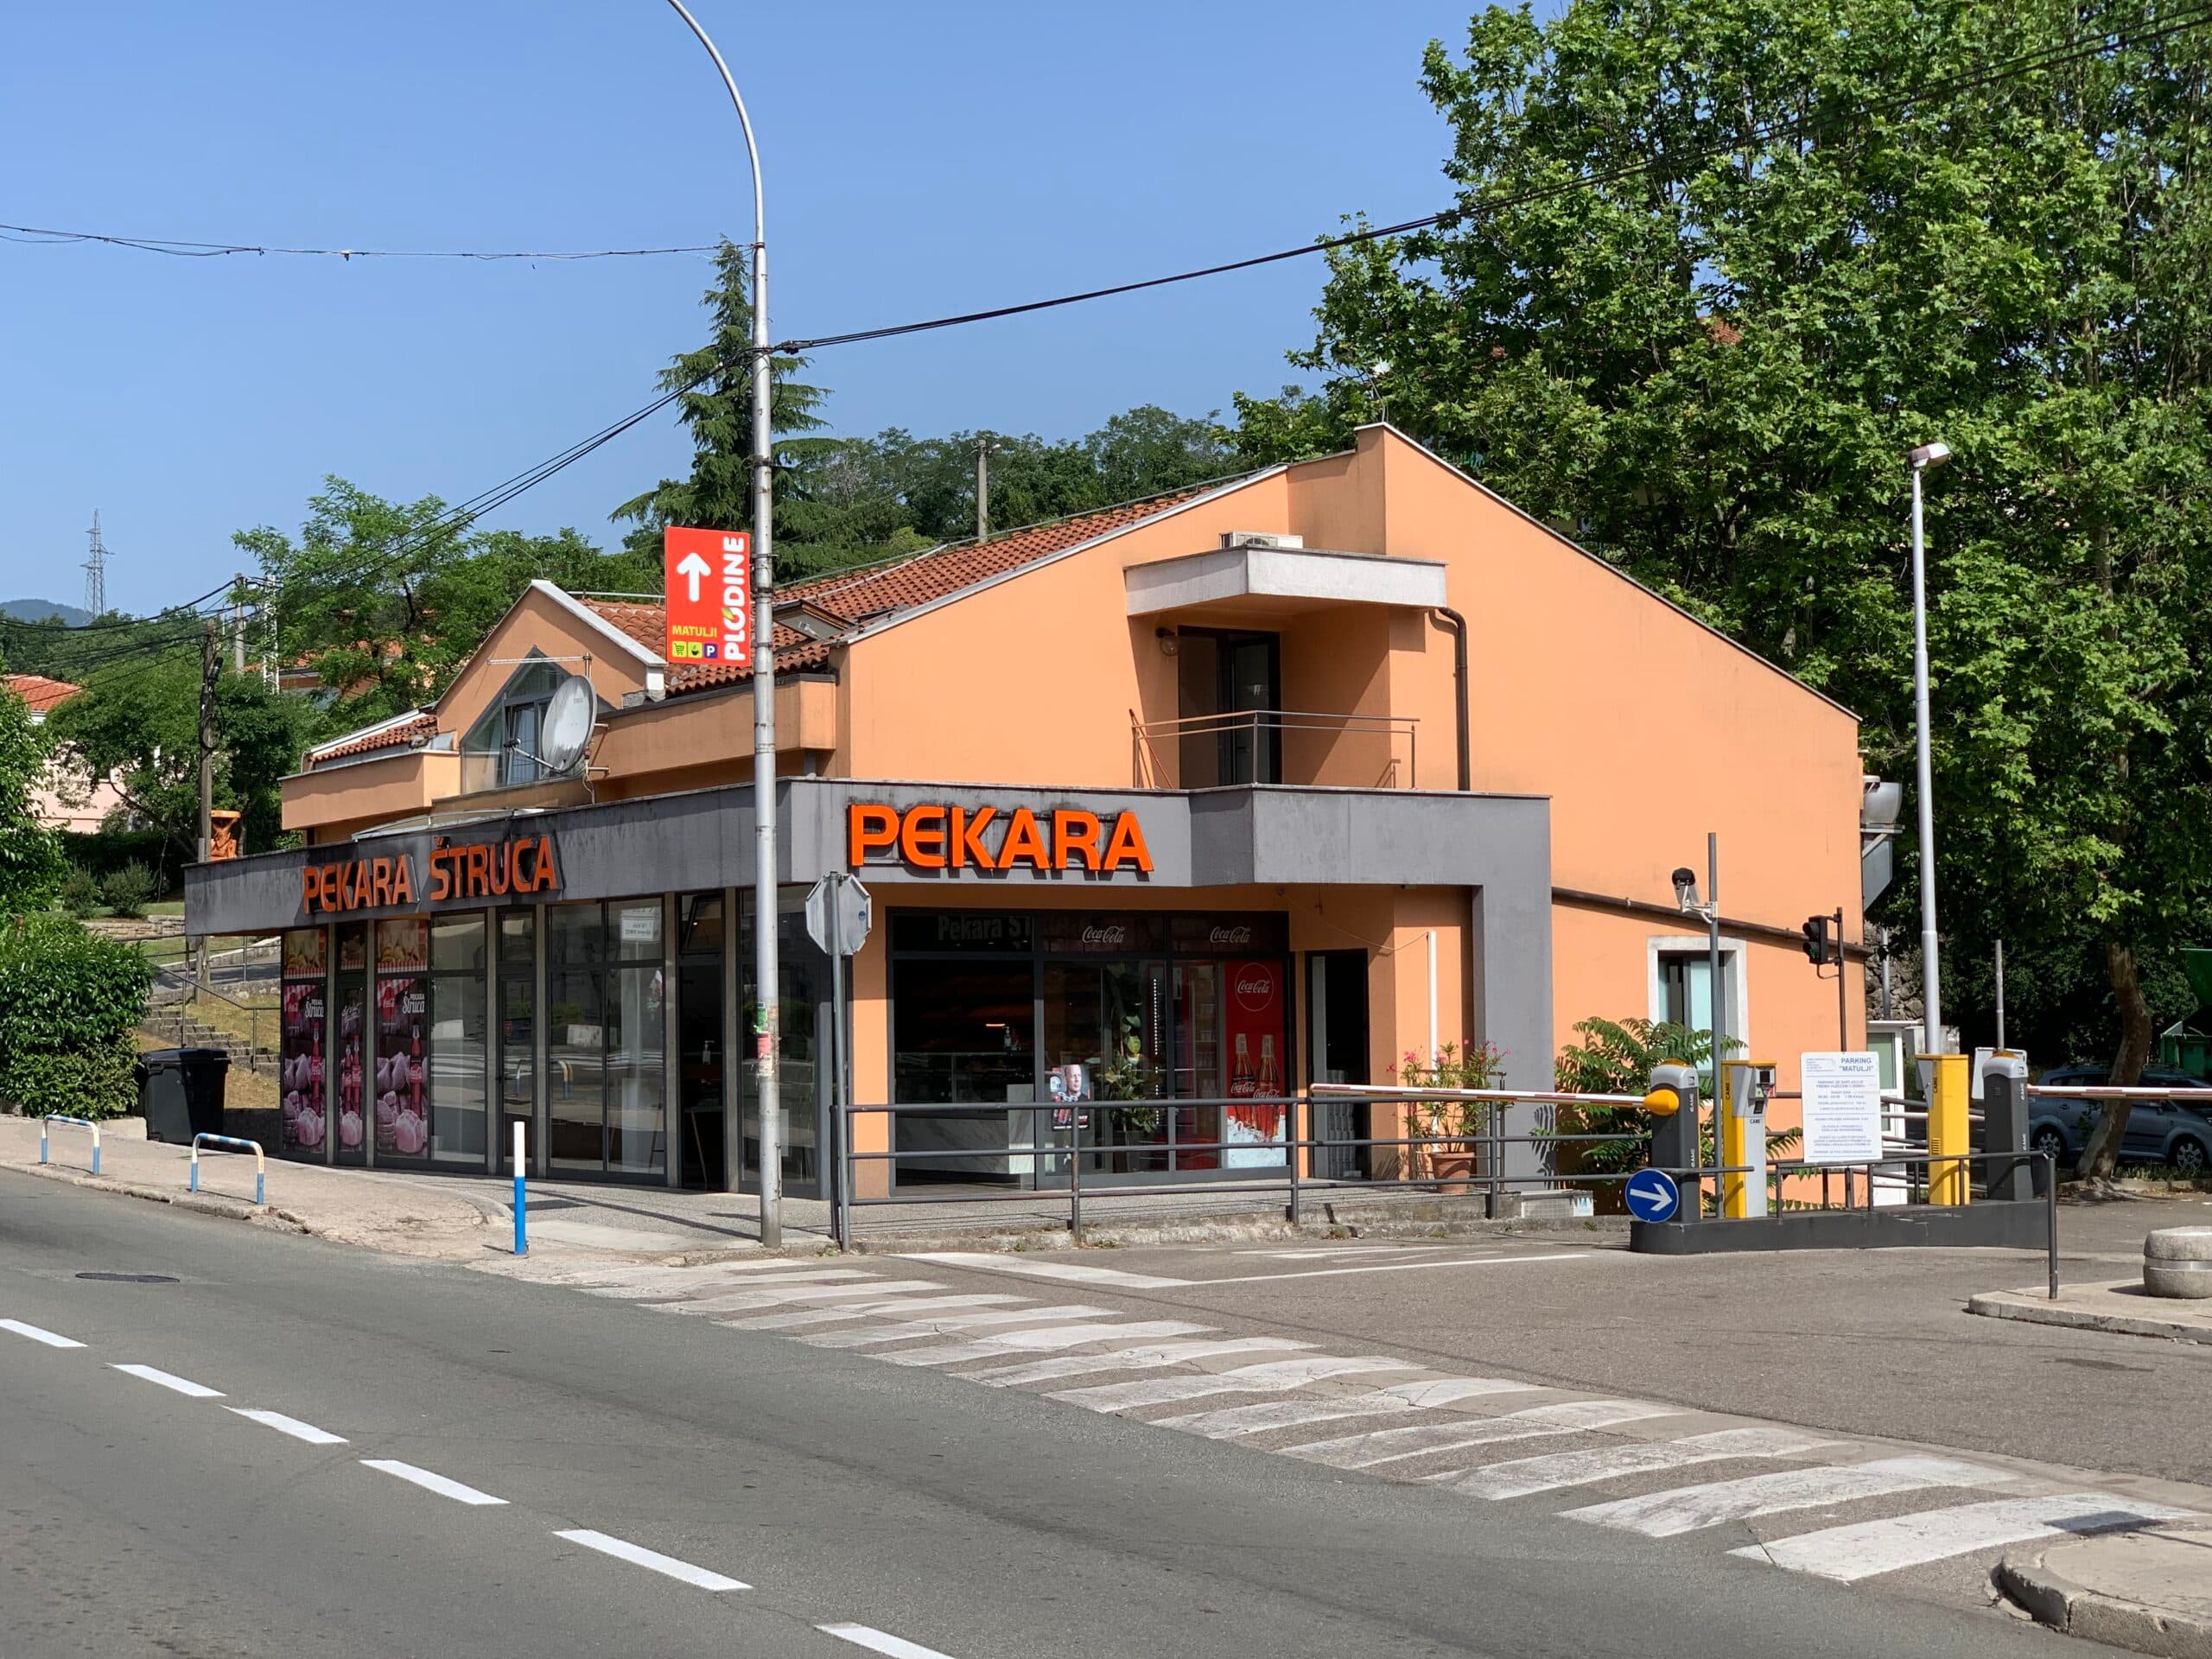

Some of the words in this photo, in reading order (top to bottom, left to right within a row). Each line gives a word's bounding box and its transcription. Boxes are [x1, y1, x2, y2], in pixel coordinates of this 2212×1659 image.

[722, 537, 746, 661] PLODINE
[672, 625, 717, 638] MATULJI
[848, 804, 1154, 872] PEKARA
[303, 855, 416, 914] PEKARA
[429, 836, 558, 900] ŠTRUCA
[1082, 925, 1126, 944] Coca-Cola
[1210, 926, 1251, 944] Coca-Cola
[1237, 979, 1272, 994] Coca-Cola
